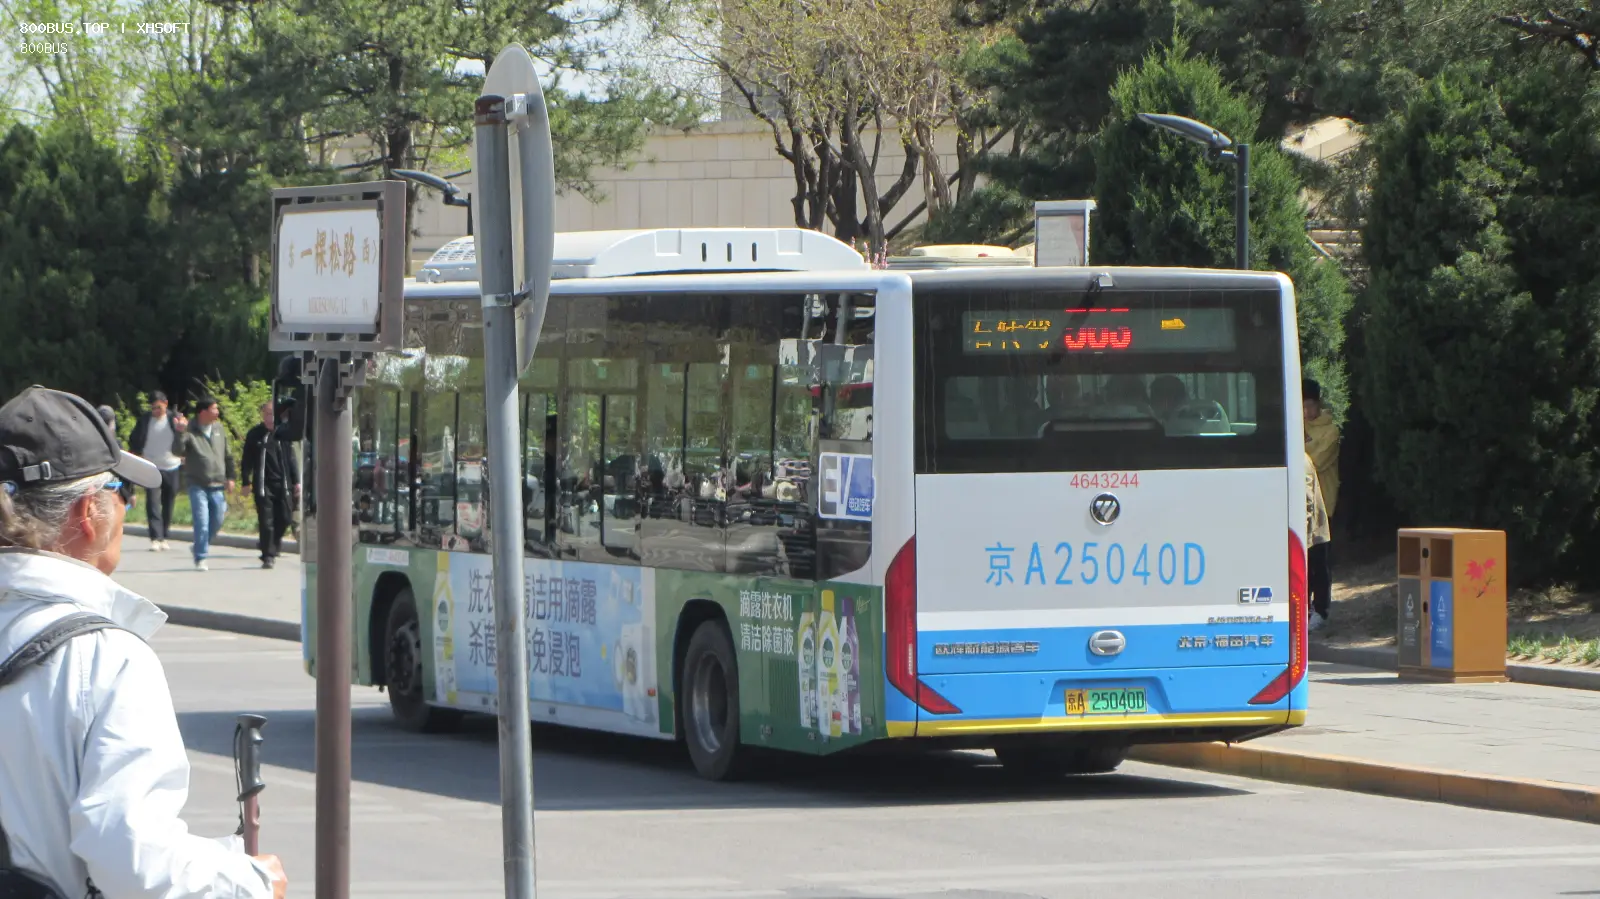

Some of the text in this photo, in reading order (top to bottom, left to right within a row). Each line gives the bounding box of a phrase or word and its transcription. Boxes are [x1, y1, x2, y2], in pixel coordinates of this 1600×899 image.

[1070, 472, 1140, 489] 4643244
[984, 541, 1206, 586] 京A25040D
[468, 569, 597, 626] 洗衣洁用滴露
[739, 590, 794, 621] 滴露洗衣机
[468, 619, 583, 678] 杀菌免浸泡
[740, 623, 795, 656] 清洁除菌液
